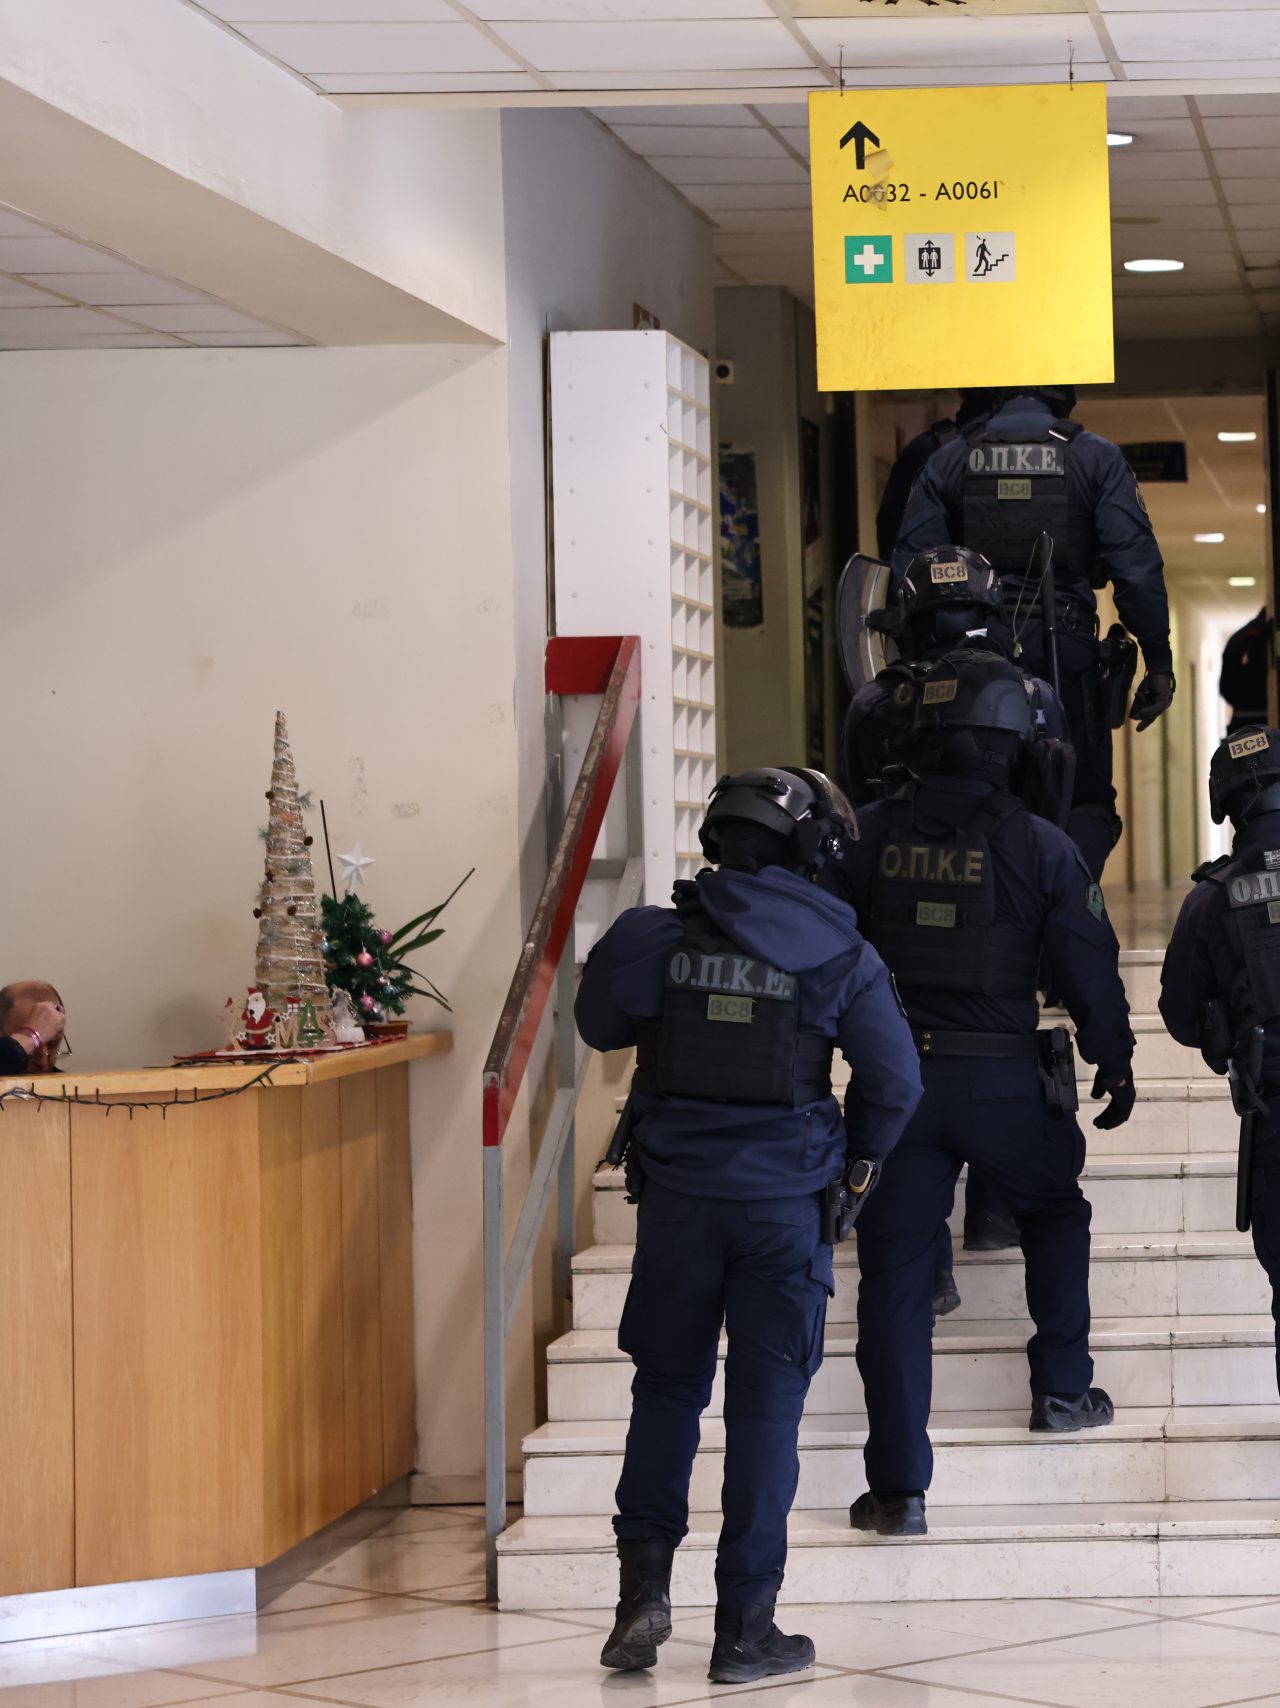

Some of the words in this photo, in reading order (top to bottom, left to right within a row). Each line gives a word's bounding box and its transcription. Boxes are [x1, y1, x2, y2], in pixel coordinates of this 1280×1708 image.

[935, 180, 999, 201] A0061
[1000, 483, 1030, 496] BC8
[933, 565, 966, 580] BC8
[1231, 737, 1266, 755] BC8
[919, 906, 955, 922] BC8
[711, 999, 750, 1017] BC8
